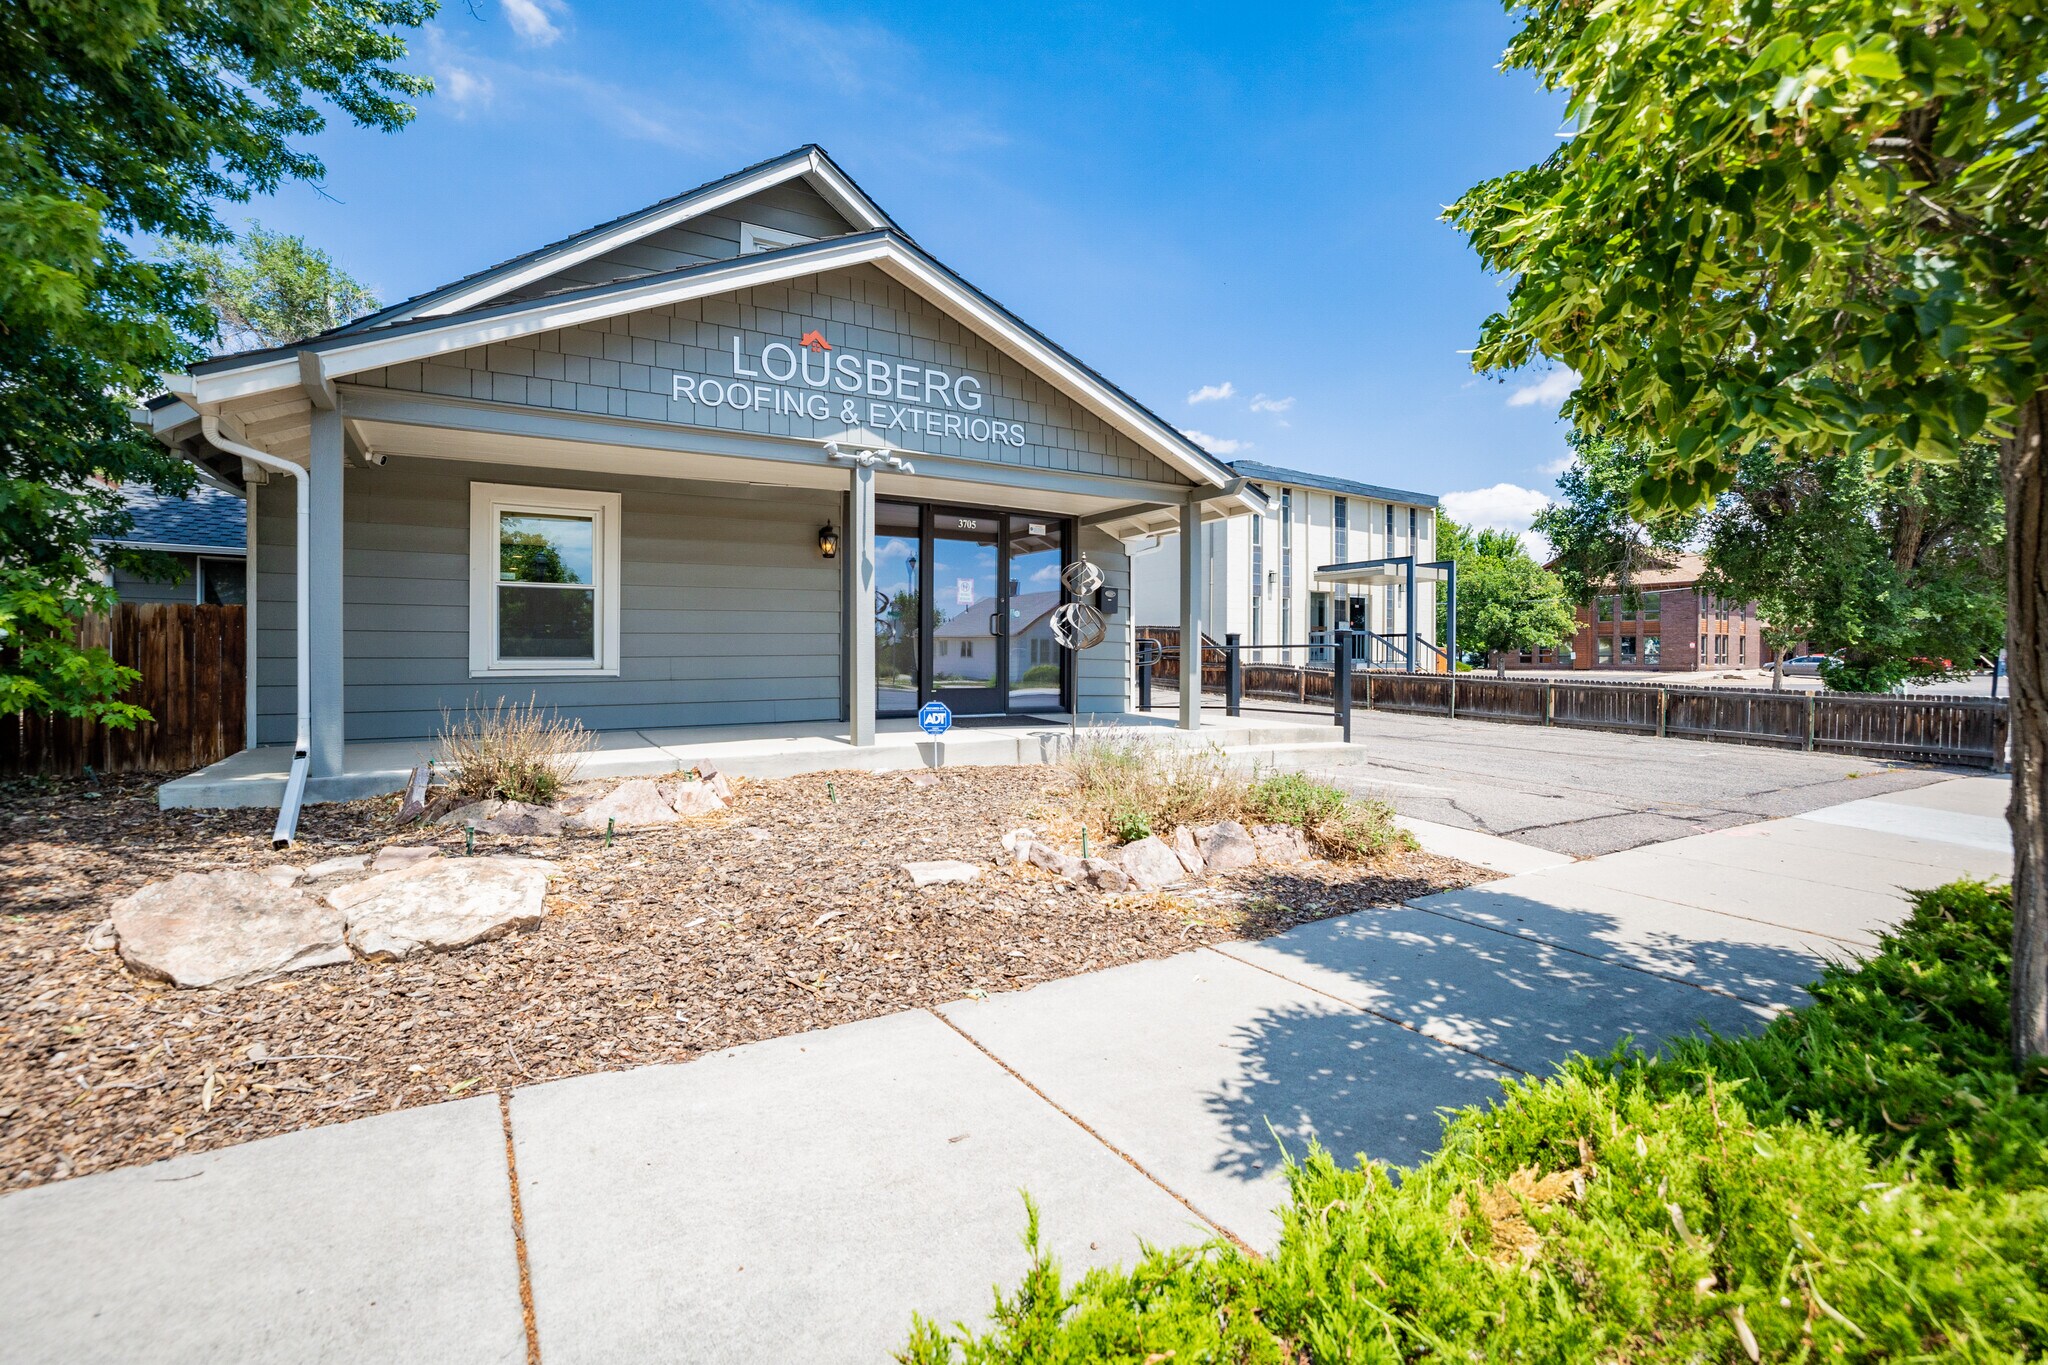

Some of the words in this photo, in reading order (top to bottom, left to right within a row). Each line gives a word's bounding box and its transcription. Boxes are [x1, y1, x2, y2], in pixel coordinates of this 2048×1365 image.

[733, 336, 982, 411] LOUSBERG
[673, 374, 830, 421] ROOFING
[840, 399, 860, 425] &
[870, 402, 1026, 447] EXTERIORS
[958, 519, 977, 529] 3705
[924, 713, 946, 724] ADT
